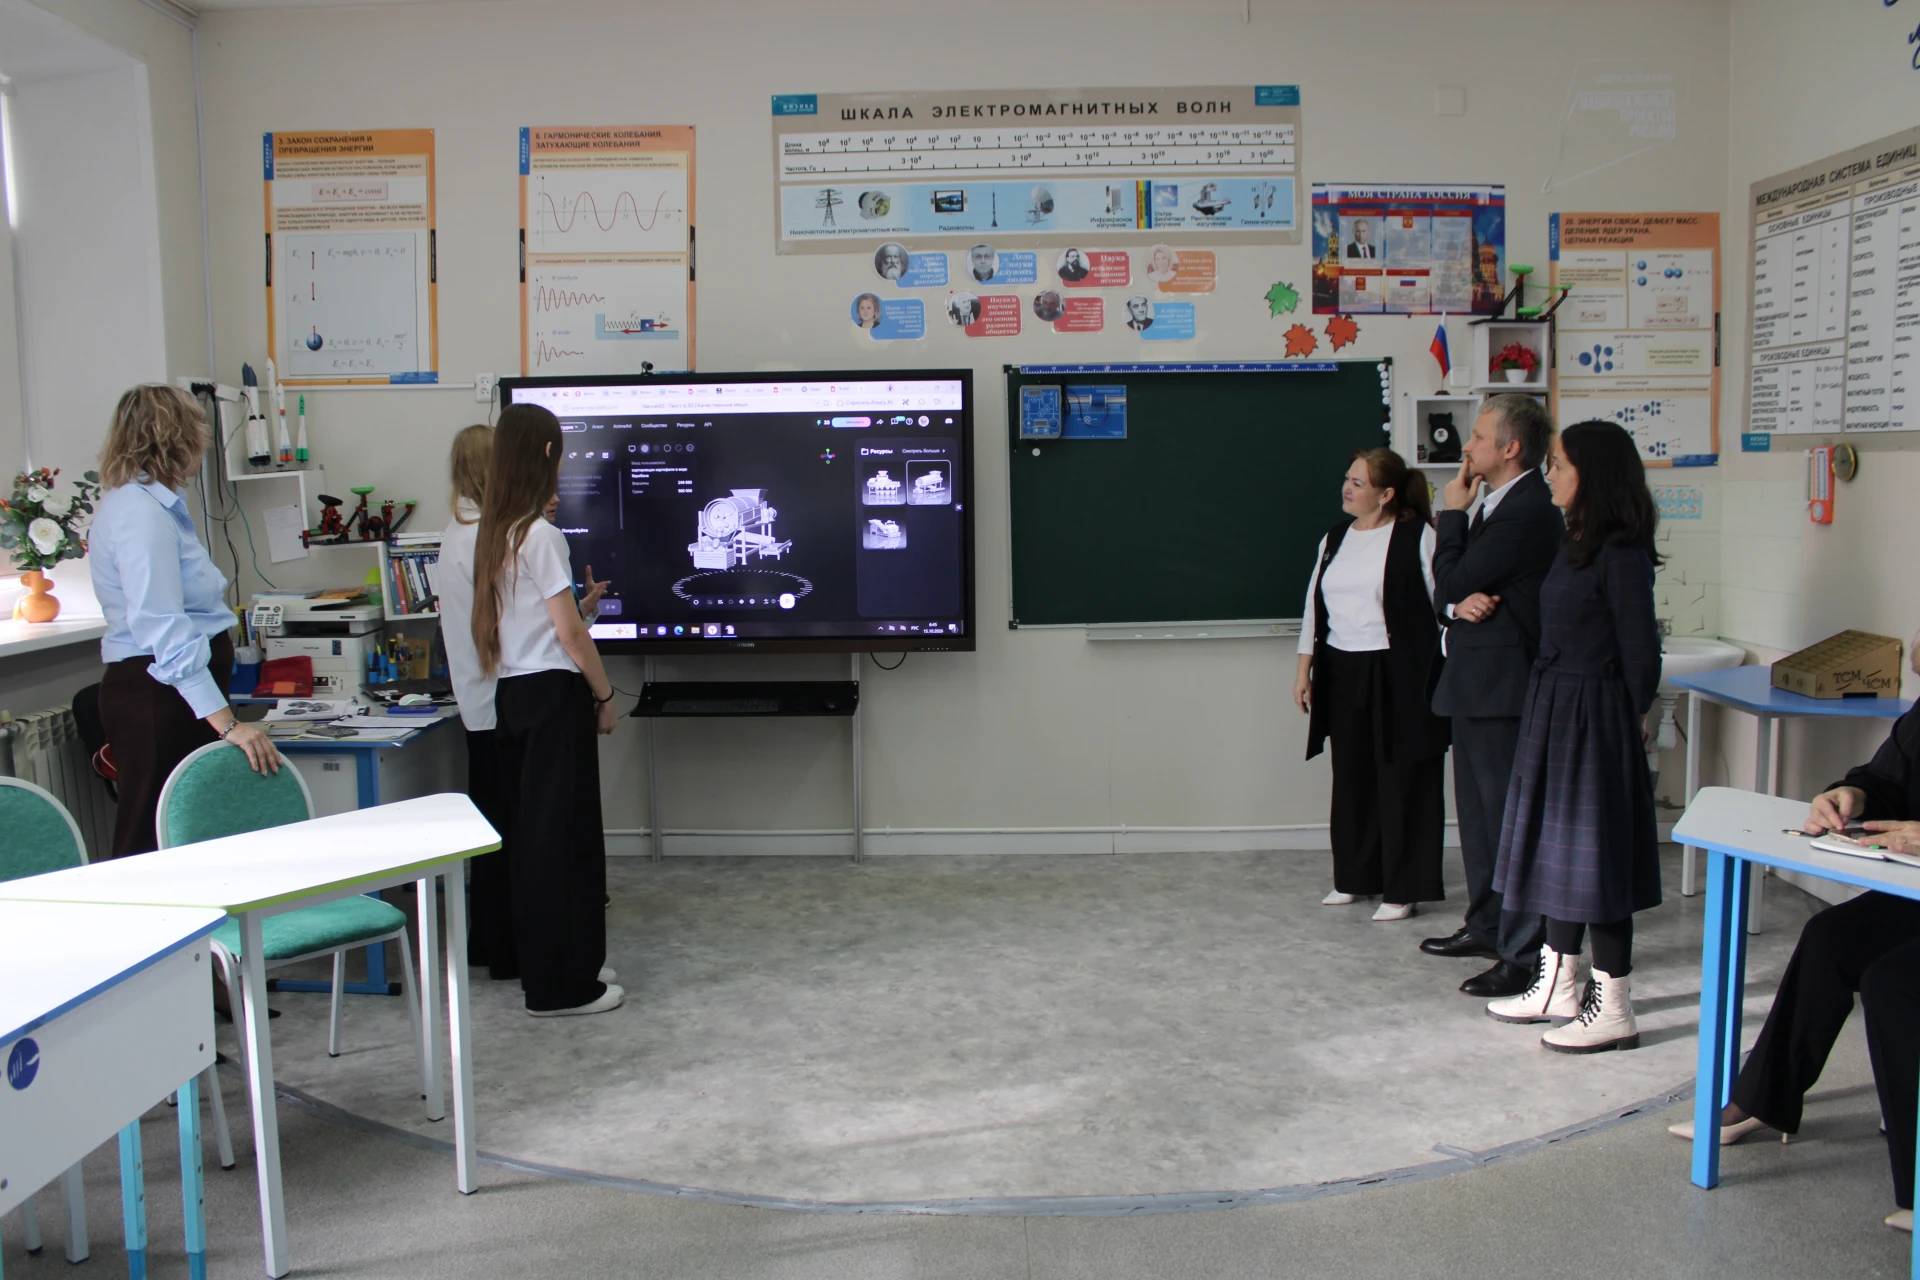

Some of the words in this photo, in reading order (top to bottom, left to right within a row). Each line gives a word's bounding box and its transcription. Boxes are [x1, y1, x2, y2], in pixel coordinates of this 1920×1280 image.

[841, 107, 914, 120] ШКАЛА
[932, 101, 1158, 117] ЭЛЕКТРОМАГНИТНЫХ
[1177, 101, 1231, 114] ВОЛН
[544, 131, 611, 139] ГАРМОНИЧЕСКИЕ
[286, 136, 312, 144] ЗАКОН
[535, 141, 590, 149] ЗАТУХАЮЩИЕ
[592, 140, 640, 148] КОЛЕБАНИЯ
[278, 146, 337, 154] ПРЕВРАЩЕНИЯ
[338, 144, 374, 152] ЭНЕРГИИ
[1756, 174, 1825, 206] МЕЖДУНАРОДНАЯ
[1829, 159, 1871, 183] СИСТЕМА
[1876, 144, 1917, 169] ЕДИНИЦ
[1348, 189, 1374, 199] МОЯ
[1377, 189, 1422, 199] СТРАНА
[1426, 189, 1471, 199] РОССИЯ
[1864, 183, 1918, 206] ПРОИЗВОДНЫЕ
[1578, 217, 1613, 225] ЭНЕРГИЯ
[1643, 217, 1674, 226] ДЕФЕКТ
[1768, 217, 1799, 233] ОСНОВНЫЕ
[1803, 208, 1832, 224] ЕДИНИЦЫ
[789, 228, 836, 236] Низкочастотные
[838, 226, 890, 235] электромагнитные
[938, 224, 975, 232] Радиоволны
[1565, 227, 1600, 235] ДЕЛЕНИЕ
[1602, 227, 1623, 235] ЯДЕР
[1565, 237, 1597, 245] ЦЕПНАЯ
[1598, 236, 1634, 244] РЕАКЦИЯ
[1011, 253, 1034, 261] Дело
[1100, 254, 1126, 262] Наука
[1008, 261, 1034, 269] науки
[1760, 349, 1800, 362] ПРОИЗВОДНЫЕ
[1801, 346, 1831, 358] ЕДИНИЦЫ
